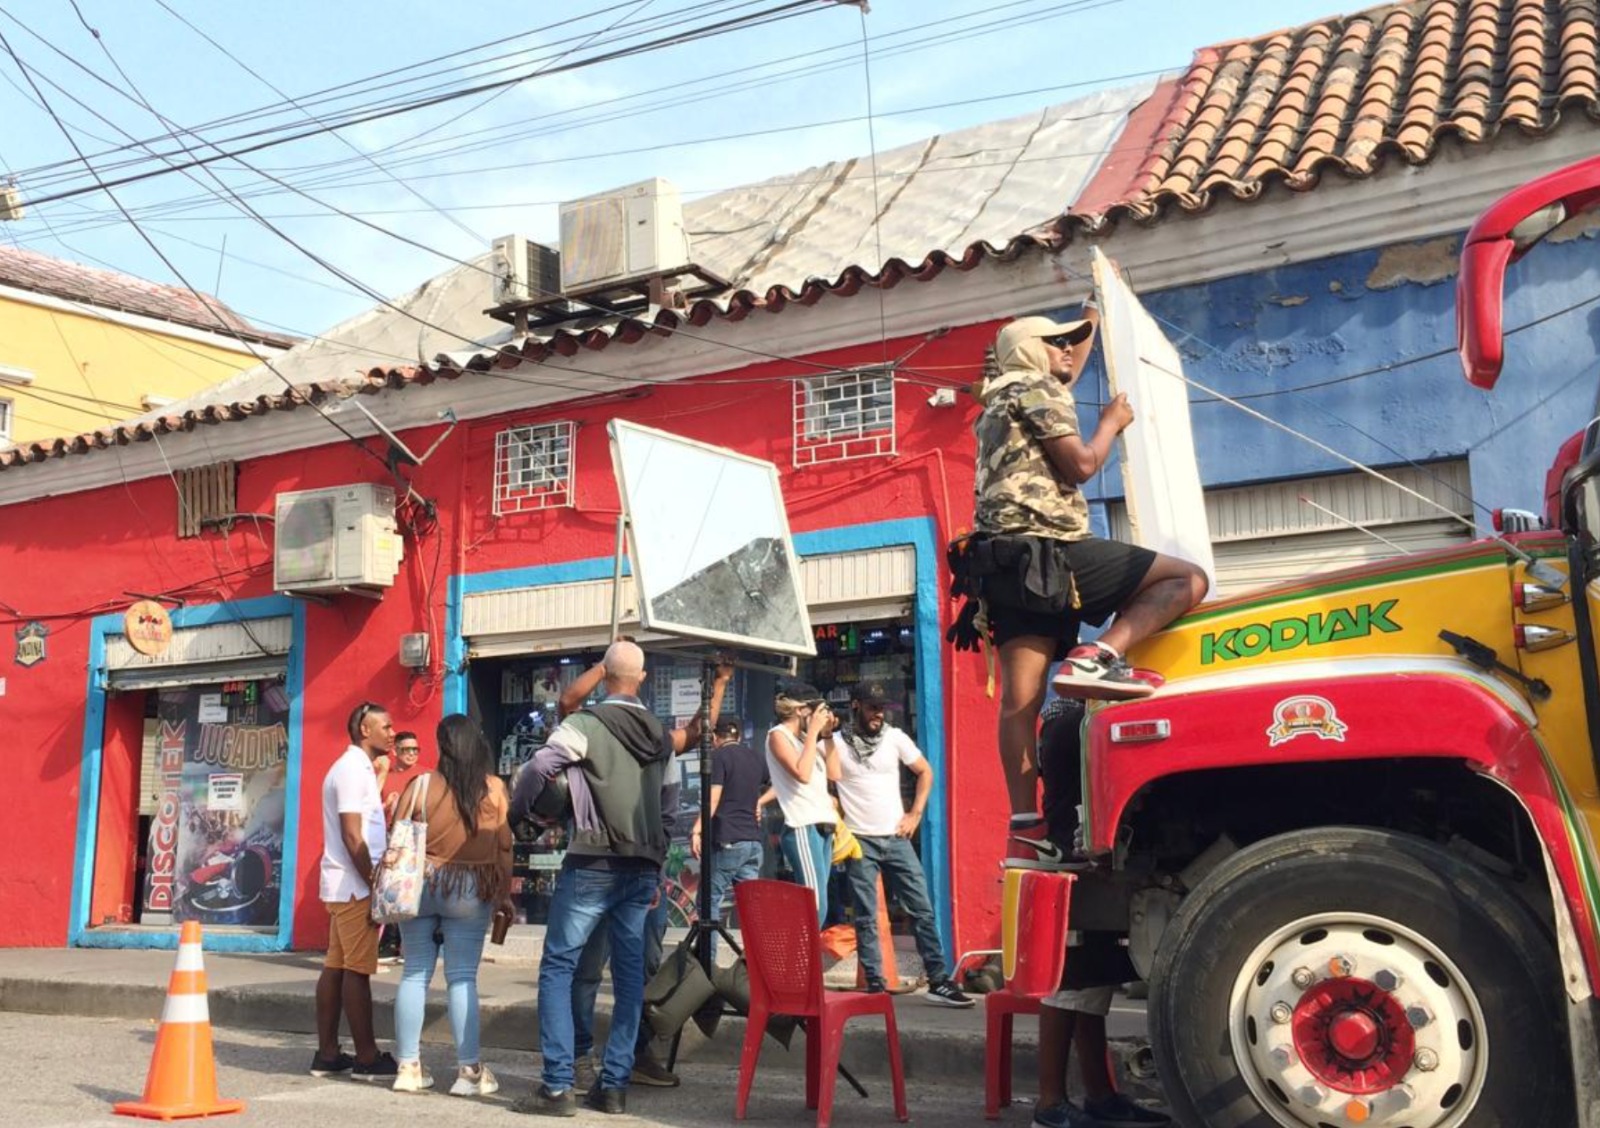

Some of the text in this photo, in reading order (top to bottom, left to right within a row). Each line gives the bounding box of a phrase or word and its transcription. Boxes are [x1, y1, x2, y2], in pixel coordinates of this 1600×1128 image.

[816, 625, 838, 639] AR
[1200, 599, 1403, 665] KODIAK
[194, 722, 289, 770] JUGADITA
[149, 719, 187, 910] DISCOTEK
